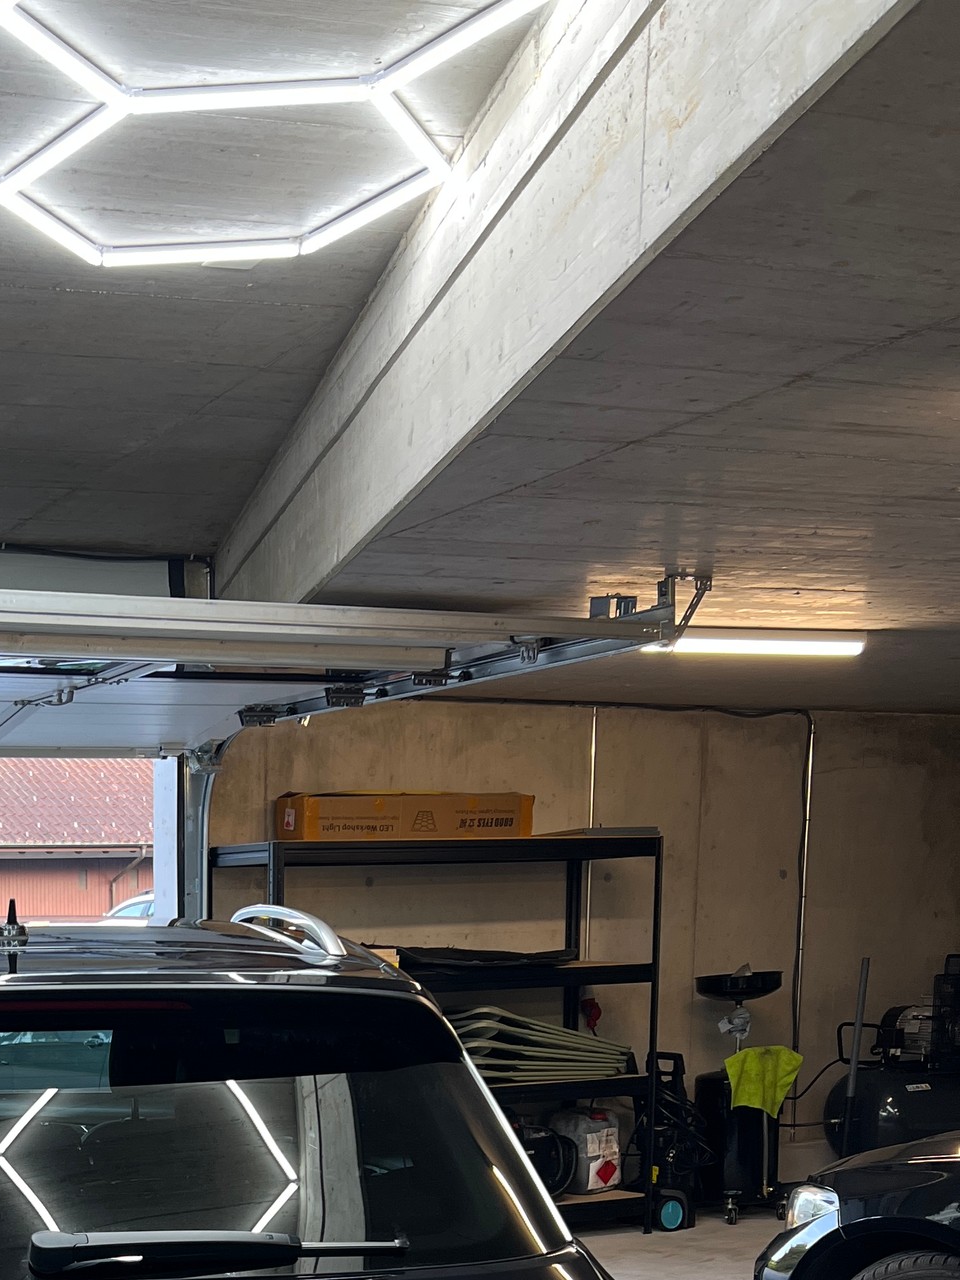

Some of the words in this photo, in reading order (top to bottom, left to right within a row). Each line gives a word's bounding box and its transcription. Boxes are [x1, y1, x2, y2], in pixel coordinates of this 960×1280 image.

[322, 823, 341, 832] Light
[342, 823, 378, 832] Workshop
[379, 824, 394, 832] LED
